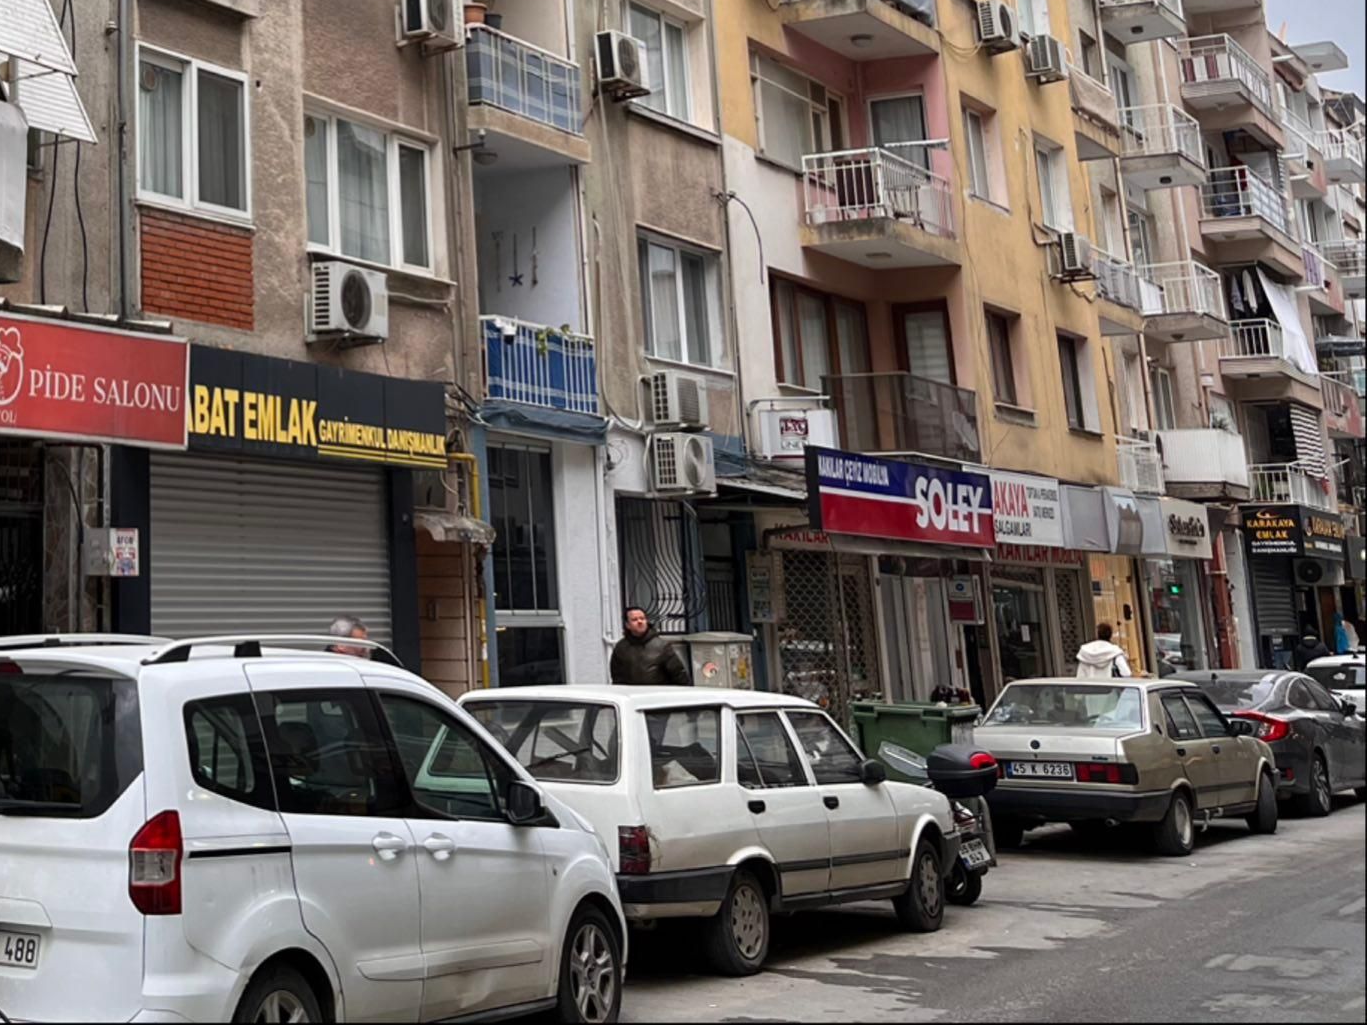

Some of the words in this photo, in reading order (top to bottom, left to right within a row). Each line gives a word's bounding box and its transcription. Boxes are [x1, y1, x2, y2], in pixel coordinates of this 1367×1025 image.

[28, 364, 86, 403] PİDE
[93, 377, 182, 414] SALONU
[243, 391, 318, 447] EMLAK
[318, 416, 386, 449] GAYRİMENKUL
[915, 475, 983, 534] SOLEY
[994, 480, 1030, 518] AKAYA
[1012, 764, 1026, 775] 45
[1030, 764, 1037, 775] K
[5, 937, 36, 963] 488
